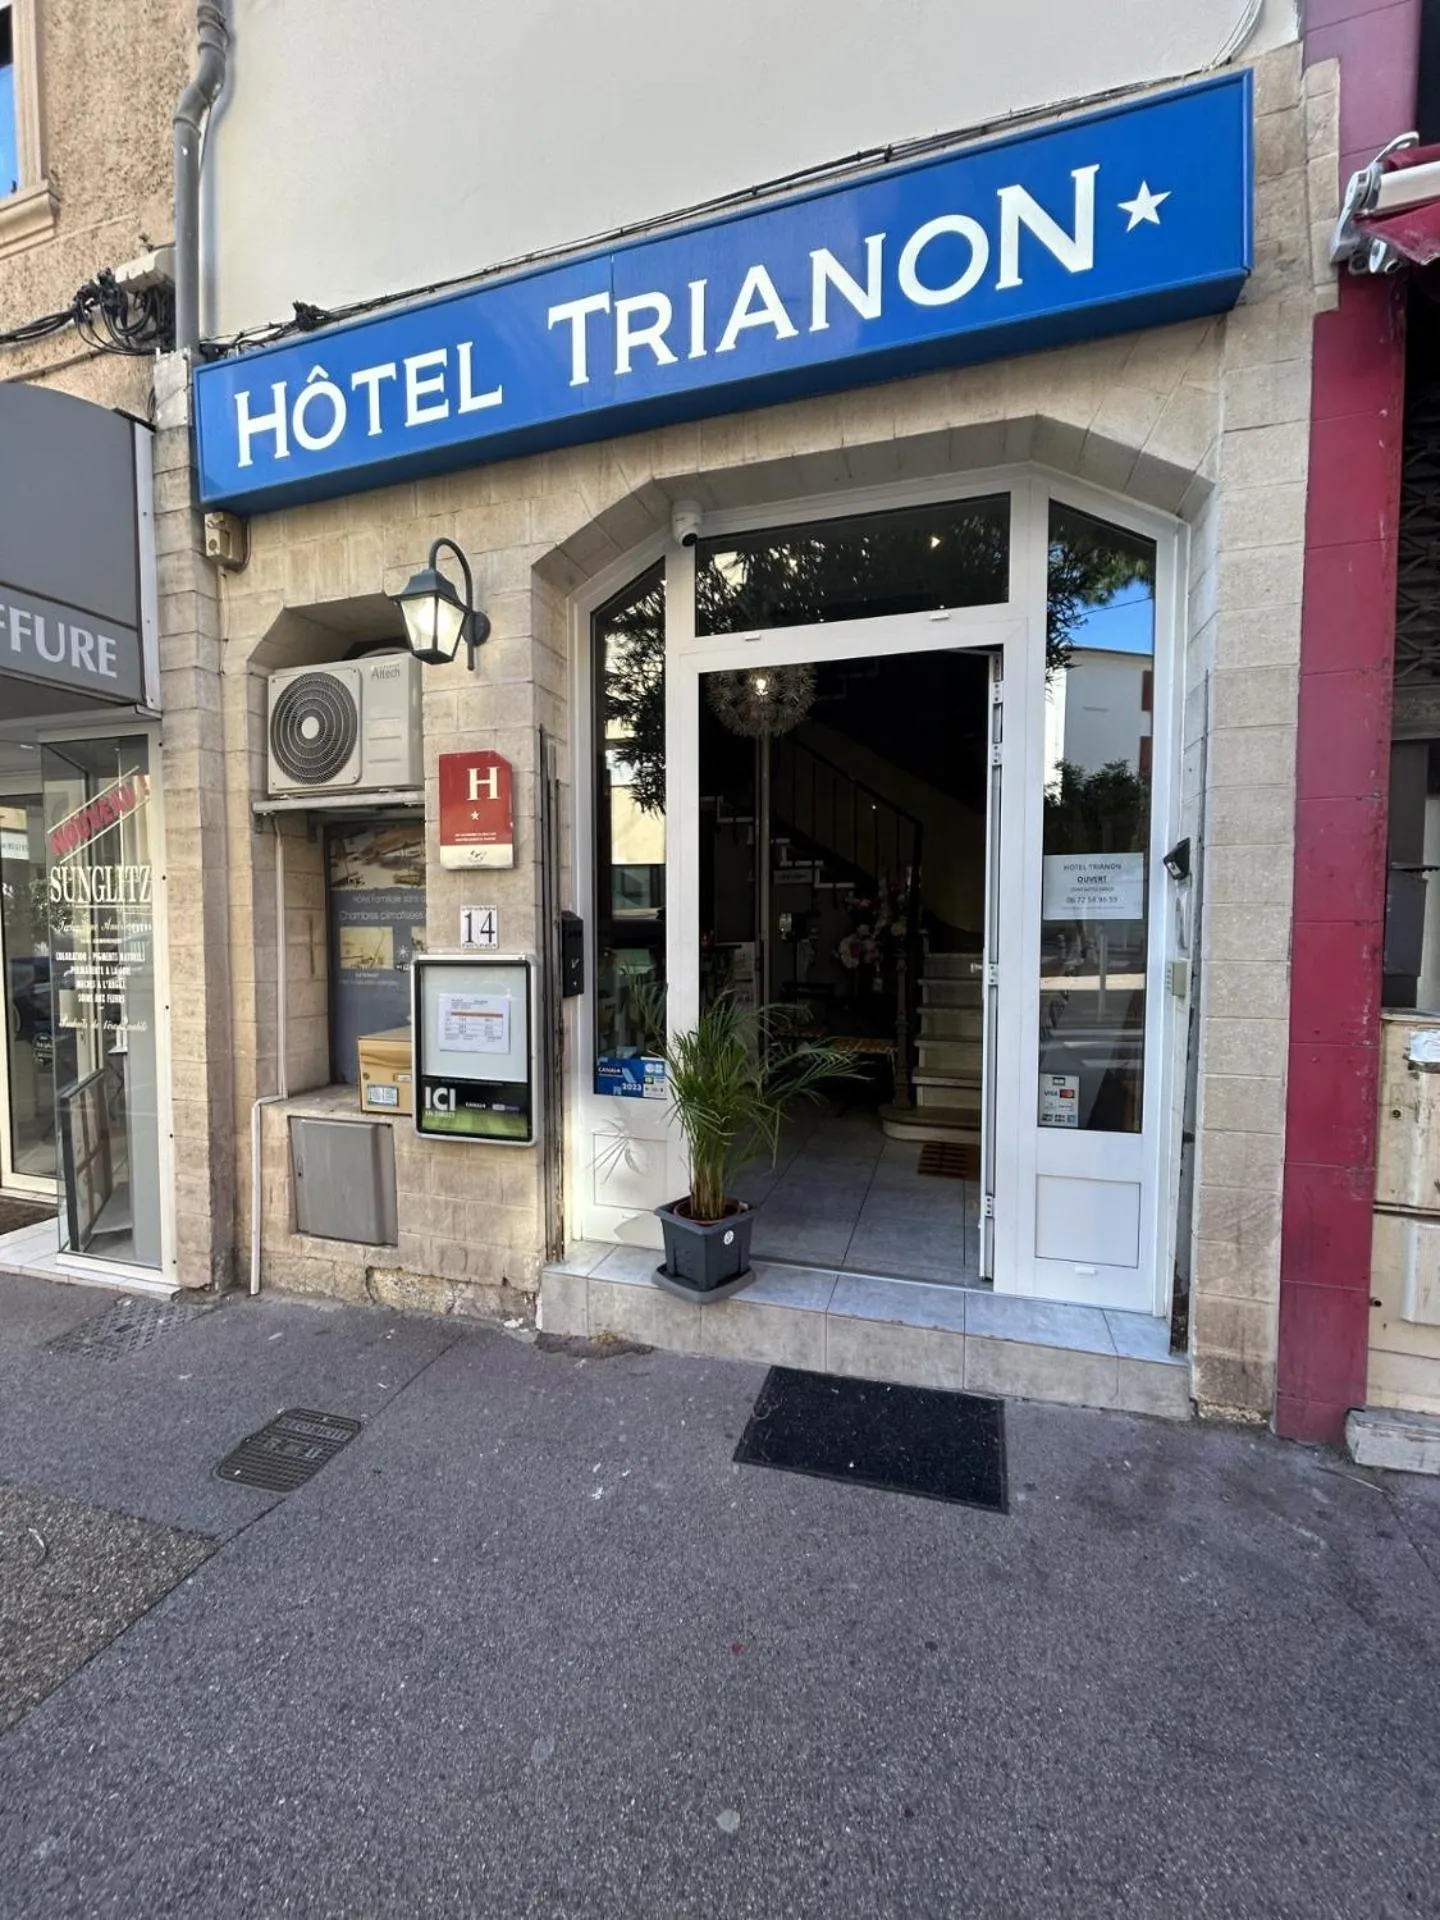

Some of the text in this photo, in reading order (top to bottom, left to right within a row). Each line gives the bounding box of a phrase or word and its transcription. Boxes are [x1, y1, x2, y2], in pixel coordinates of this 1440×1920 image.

[234, 164, 1100, 468] HÔTEL TRIANON
[0, 604, 117, 678] FURE
[467, 766, 501, 801] H
[50, 865, 152, 902] SUNGLITZ
[1077, 875, 1108, 884] OUVERT
[464, 911, 496, 943] 14
[424, 1086, 457, 1112] ICI
[621, 1082, 642, 1091] 2023
